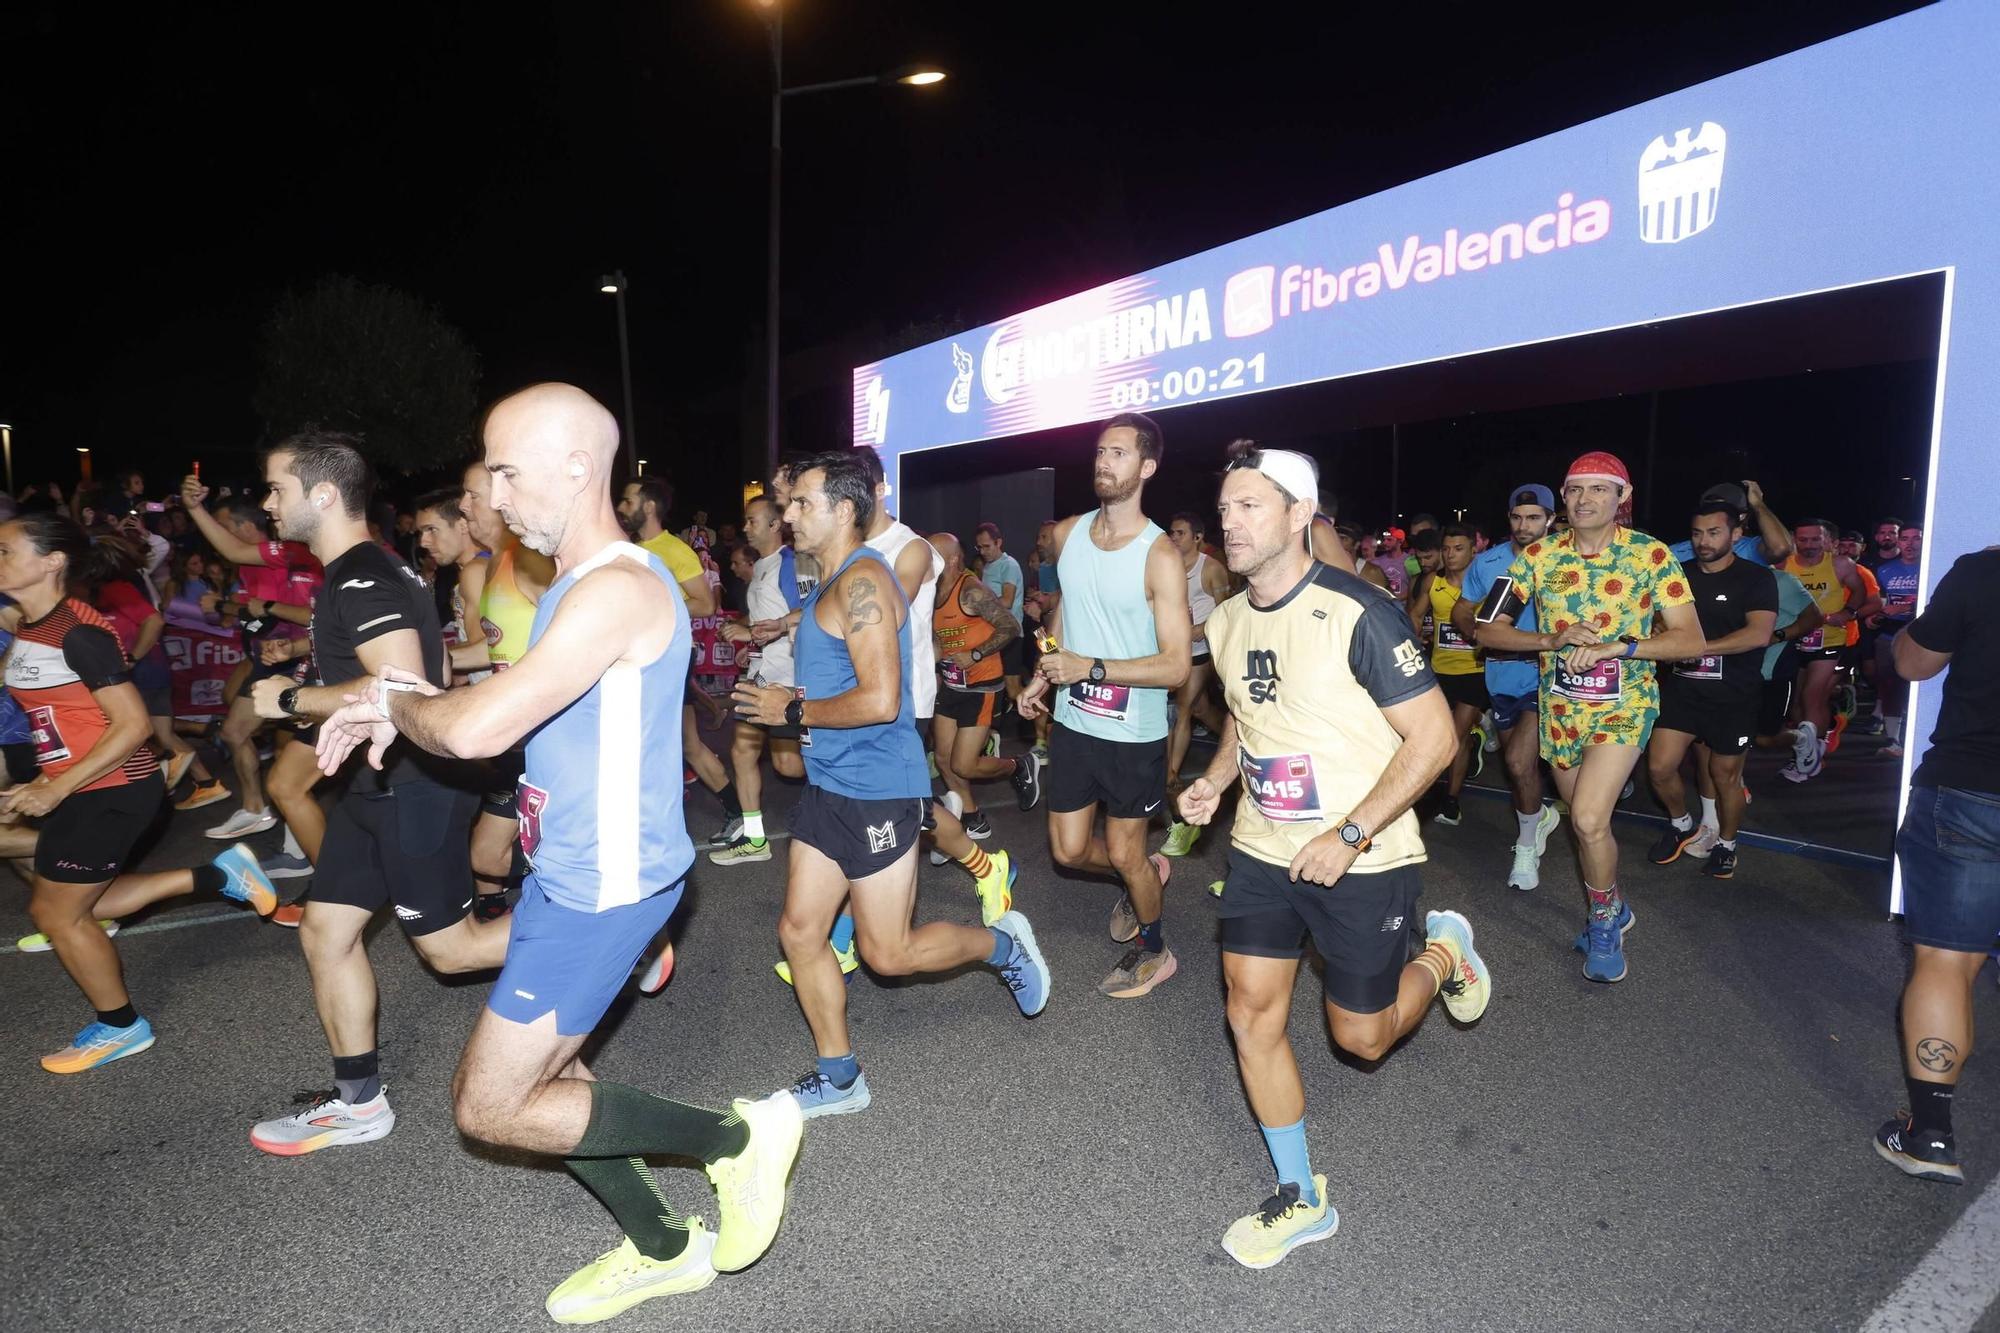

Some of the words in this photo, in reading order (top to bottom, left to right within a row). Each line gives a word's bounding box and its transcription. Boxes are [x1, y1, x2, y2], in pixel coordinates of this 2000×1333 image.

[1279, 192, 1612, 317] fibraValencia
[1024, 288, 1213, 383] NOCTURNA
[1109, 351, 1267, 410] 00:00:21
[1081, 681, 1114, 702] 1118
[1561, 672, 1608, 688] 2088
